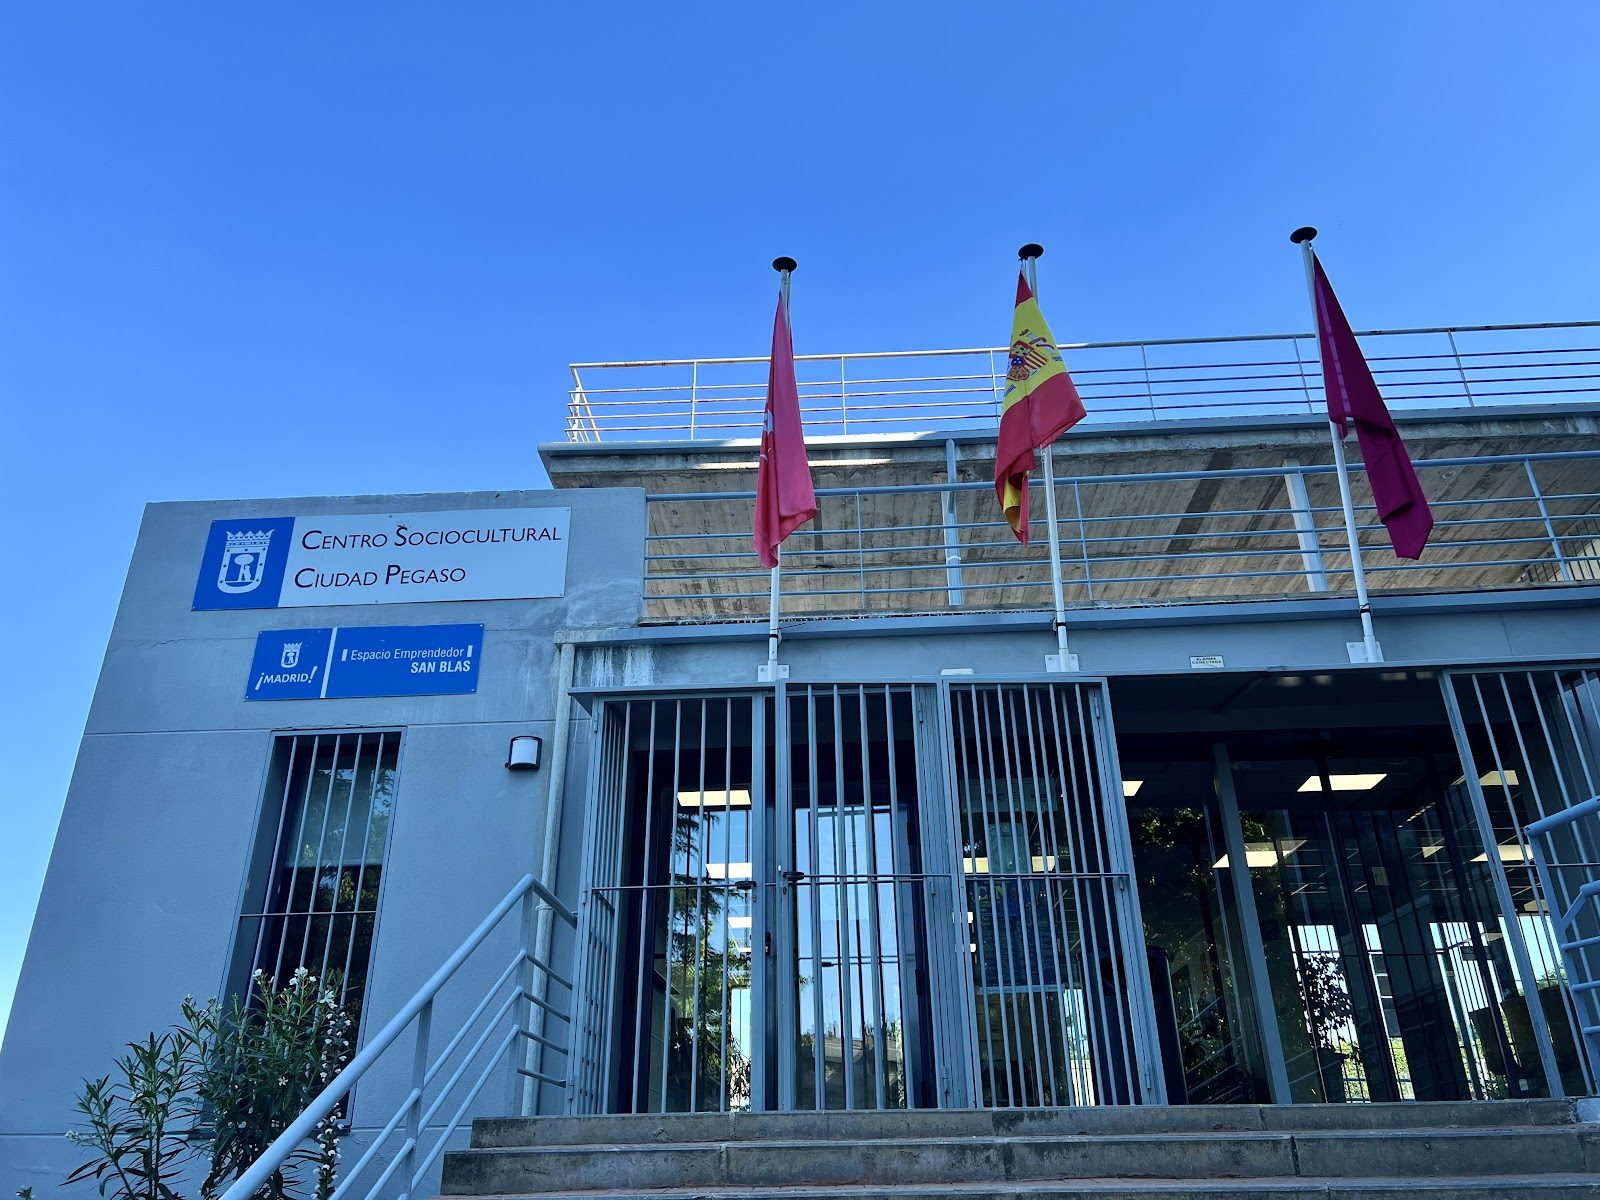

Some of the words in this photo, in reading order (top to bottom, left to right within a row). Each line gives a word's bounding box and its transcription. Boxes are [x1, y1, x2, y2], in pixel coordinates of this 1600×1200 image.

[302, 530, 388, 550] CENTRO
[394, 526, 562, 547] SOCIOCULTURAL
[294, 568, 378, 588] CIUDAD
[385, 564, 466, 585] PEGASO
[350, 649, 391, 662] Espacio
[394, 646, 465, 660] Emprendedor
[255, 665, 318, 691] ¡MADRID!
[410, 661, 436, 673] SAN
[439, 660, 471, 673] BLAS
